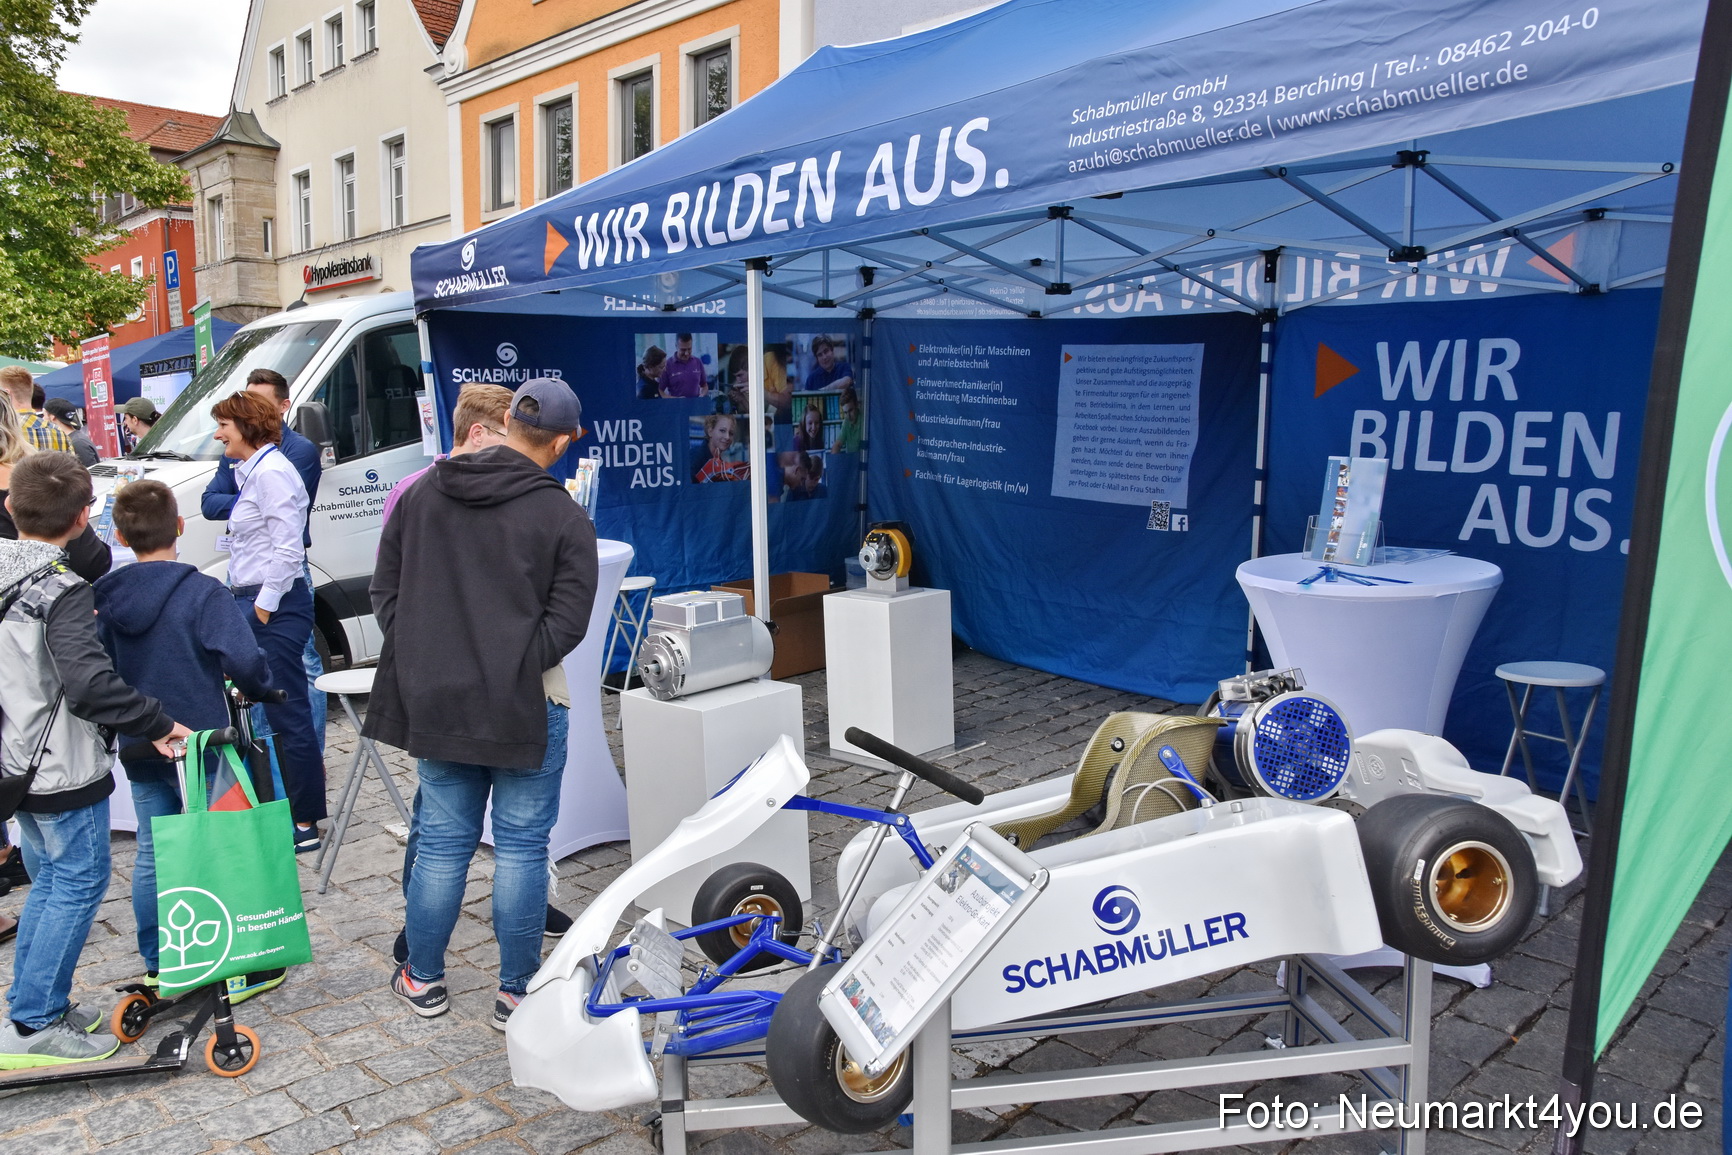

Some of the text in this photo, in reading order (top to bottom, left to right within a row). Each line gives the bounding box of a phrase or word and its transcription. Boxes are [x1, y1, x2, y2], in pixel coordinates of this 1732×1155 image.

[1067, 103, 1187, 150] Industriestraße
[1191, 103, 1207, 125] 8,
[1212, 90, 1268, 119] 92334
[1273, 71, 1363, 107] Berching
[1384, 53, 1429, 81] Tel.:
[1437, 30, 1512, 67] 08462
[1521, 6, 1599, 47] 204-0
[1071, 75, 1228, 125] Schabmüller GmbH
[1067, 121, 1263, 175] azubi@schabmueller.de
[1277, 61, 1528, 131] www.schabmueller.de
[574, 117, 1010, 270] WIR BILDEN AUS.
[166, 256, 175, 285] P
[310, 252, 373, 285] HypoVereinsbank
[434, 264, 508, 298] SCHABMÜLLER
[919, 344, 1031, 357] Elektroniker(in) für Maschinen
[1087, 355, 1106, 363] bieten
[918, 358, 990, 369] und Antriebstechnik
[1075, 367, 1096, 375] pektive
[1376, 338, 1521, 401] WIR
[917, 377, 1003, 393] Feinwerkmechaniker(in)
[915, 391, 1018, 406] Fachrichtung Maschinenbau
[1082, 389, 1118, 397] Firmenkultur
[1120, 392, 1139, 400] sorgen
[1140, 390, 1150, 398] für
[1130, 402, 1136, 410] in
[1137, 402, 1150, 410] dem
[1153, 403, 1174, 411] Lernen
[914, 413, 1001, 430] Industriekaufmann/frau
[1073, 422, 1098, 431] Facebook
[1120, 425, 1138, 433] Unsere
[1139, 427, 1190, 436] Auszubildenden
[593, 419, 643, 443] WIR
[1072, 435, 1089, 443] geben
[1090, 435, 1099, 443] dir
[1165, 439, 1174, 447] du
[1350, 409, 1621, 480] BILDEN
[588, 442, 673, 468] BILDEN
[1071, 446, 1082, 454] gen
[1099, 447, 1123, 456] Möchtest
[1124, 449, 1133, 457] du
[1135, 450, 1152, 458] einer
[1071, 457, 1092, 465] werden,
[1093, 458, 1107, 466] dann
[1108, 460, 1124, 468] sende
[1125, 461, 1143, 469] deine
[630, 466, 681, 489] AUS.
[943, 473, 955, 484] für
[956, 475, 1002, 491] Lagerlogistik
[1004, 481, 1029, 495] (m/w)
[1069, 469, 1098, 478] unterlagen
[1099, 470, 1107, 478] bis
[1108, 472, 1140, 480] spätestens
[1143, 474, 1159, 482] Ende
[1077, 480, 1089, 488] Post
[1102, 482, 1120, 491] E-Mail
[1129, 484, 1144, 493] Frau
[311, 496, 388, 513] Schabmüller Gmb
[1458, 483, 1631, 555] AUS.
[236, 907, 285, 922] Gesundheit
[236, 911, 304, 933] in besten Händen
[229, 944, 285, 962] www.aok.de/bayern
[1002, 912, 1250, 995] SCHABMÜLLER
[425, 994, 446, 1005] adidas
